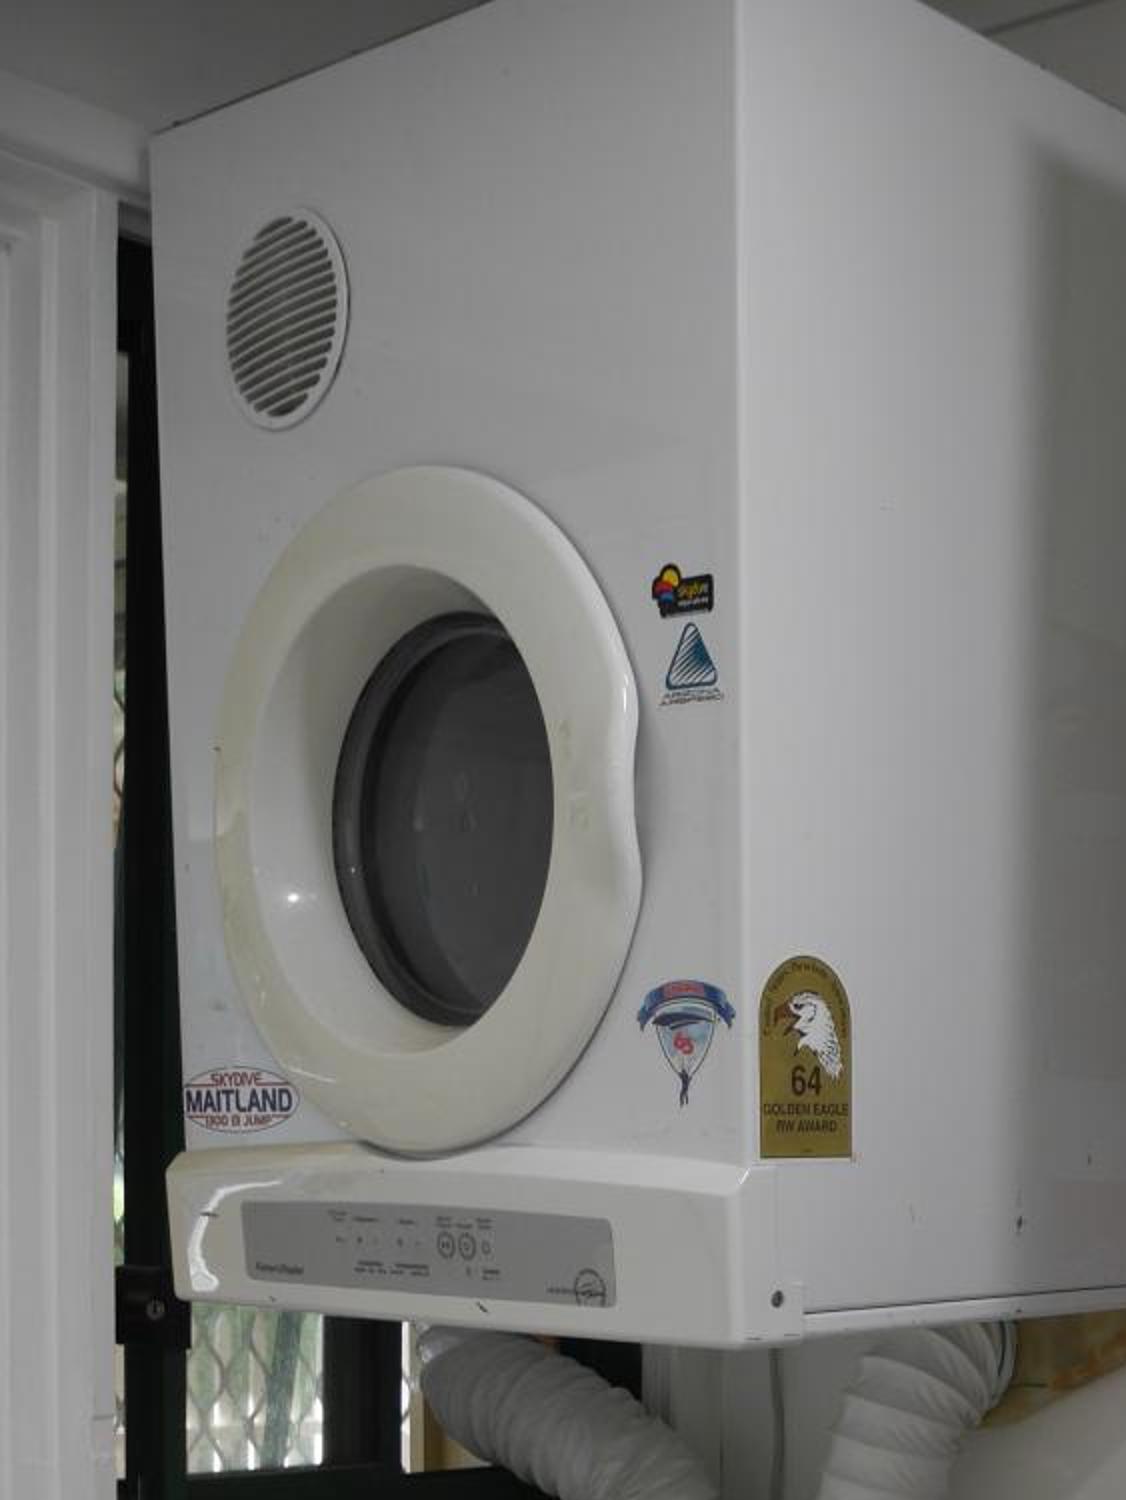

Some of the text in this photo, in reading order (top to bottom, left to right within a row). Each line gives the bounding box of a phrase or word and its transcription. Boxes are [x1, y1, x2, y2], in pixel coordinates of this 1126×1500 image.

[210, 1072, 263, 1087] SKYDIVE
[791, 1065, 822, 1097] 64
[185, 1088, 293, 1113] MAITLAND
[763, 1103, 849, 1117] GOLDEN EAGLE
[797, 1120, 838, 1134] AWARD
